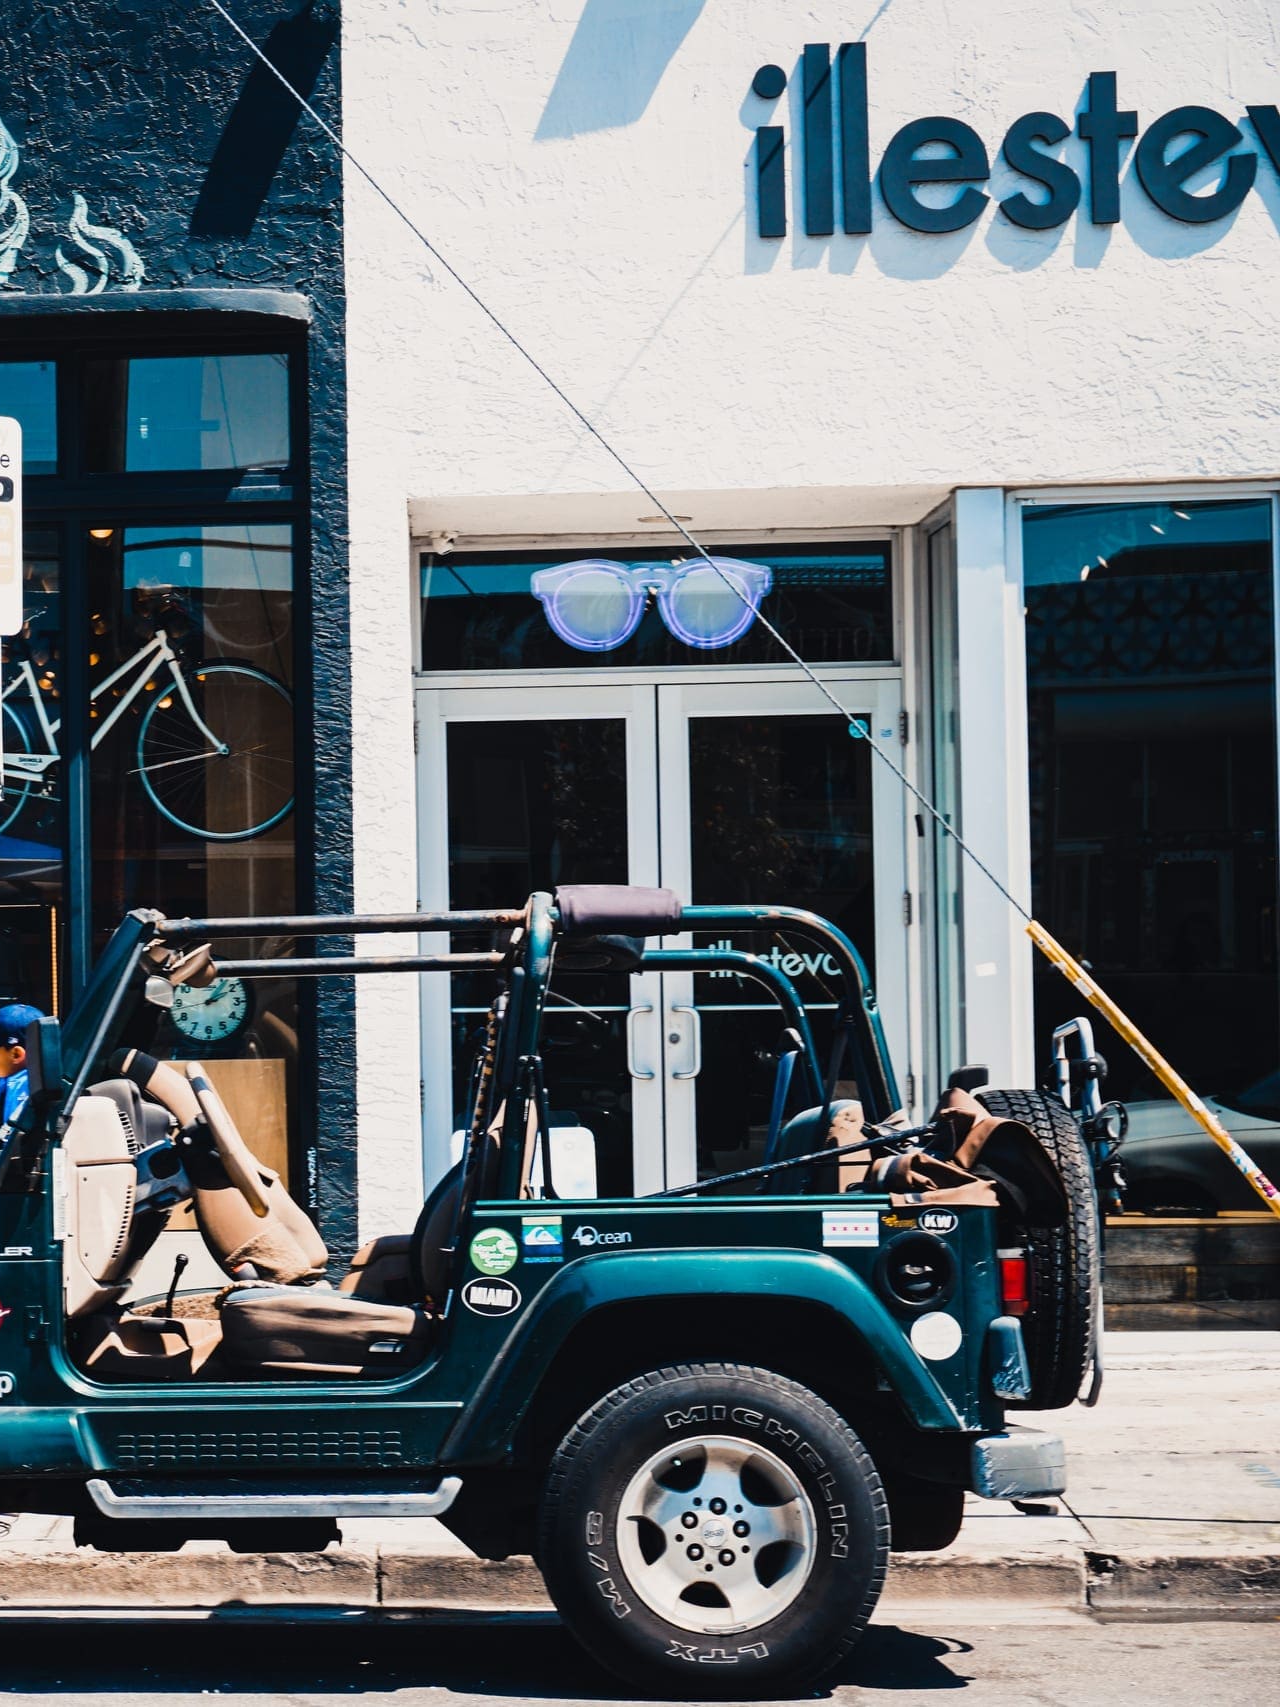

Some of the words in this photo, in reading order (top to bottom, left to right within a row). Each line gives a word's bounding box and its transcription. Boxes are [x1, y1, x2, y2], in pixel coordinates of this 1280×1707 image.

[923, 1214, 952, 1228] KW
[571, 1225, 632, 1247] 4Ocean
[470, 1286, 513, 1307] MIAMI
[663, 1405, 850, 1560] MICHELIN
[665, 1639, 770, 1664] LTX
